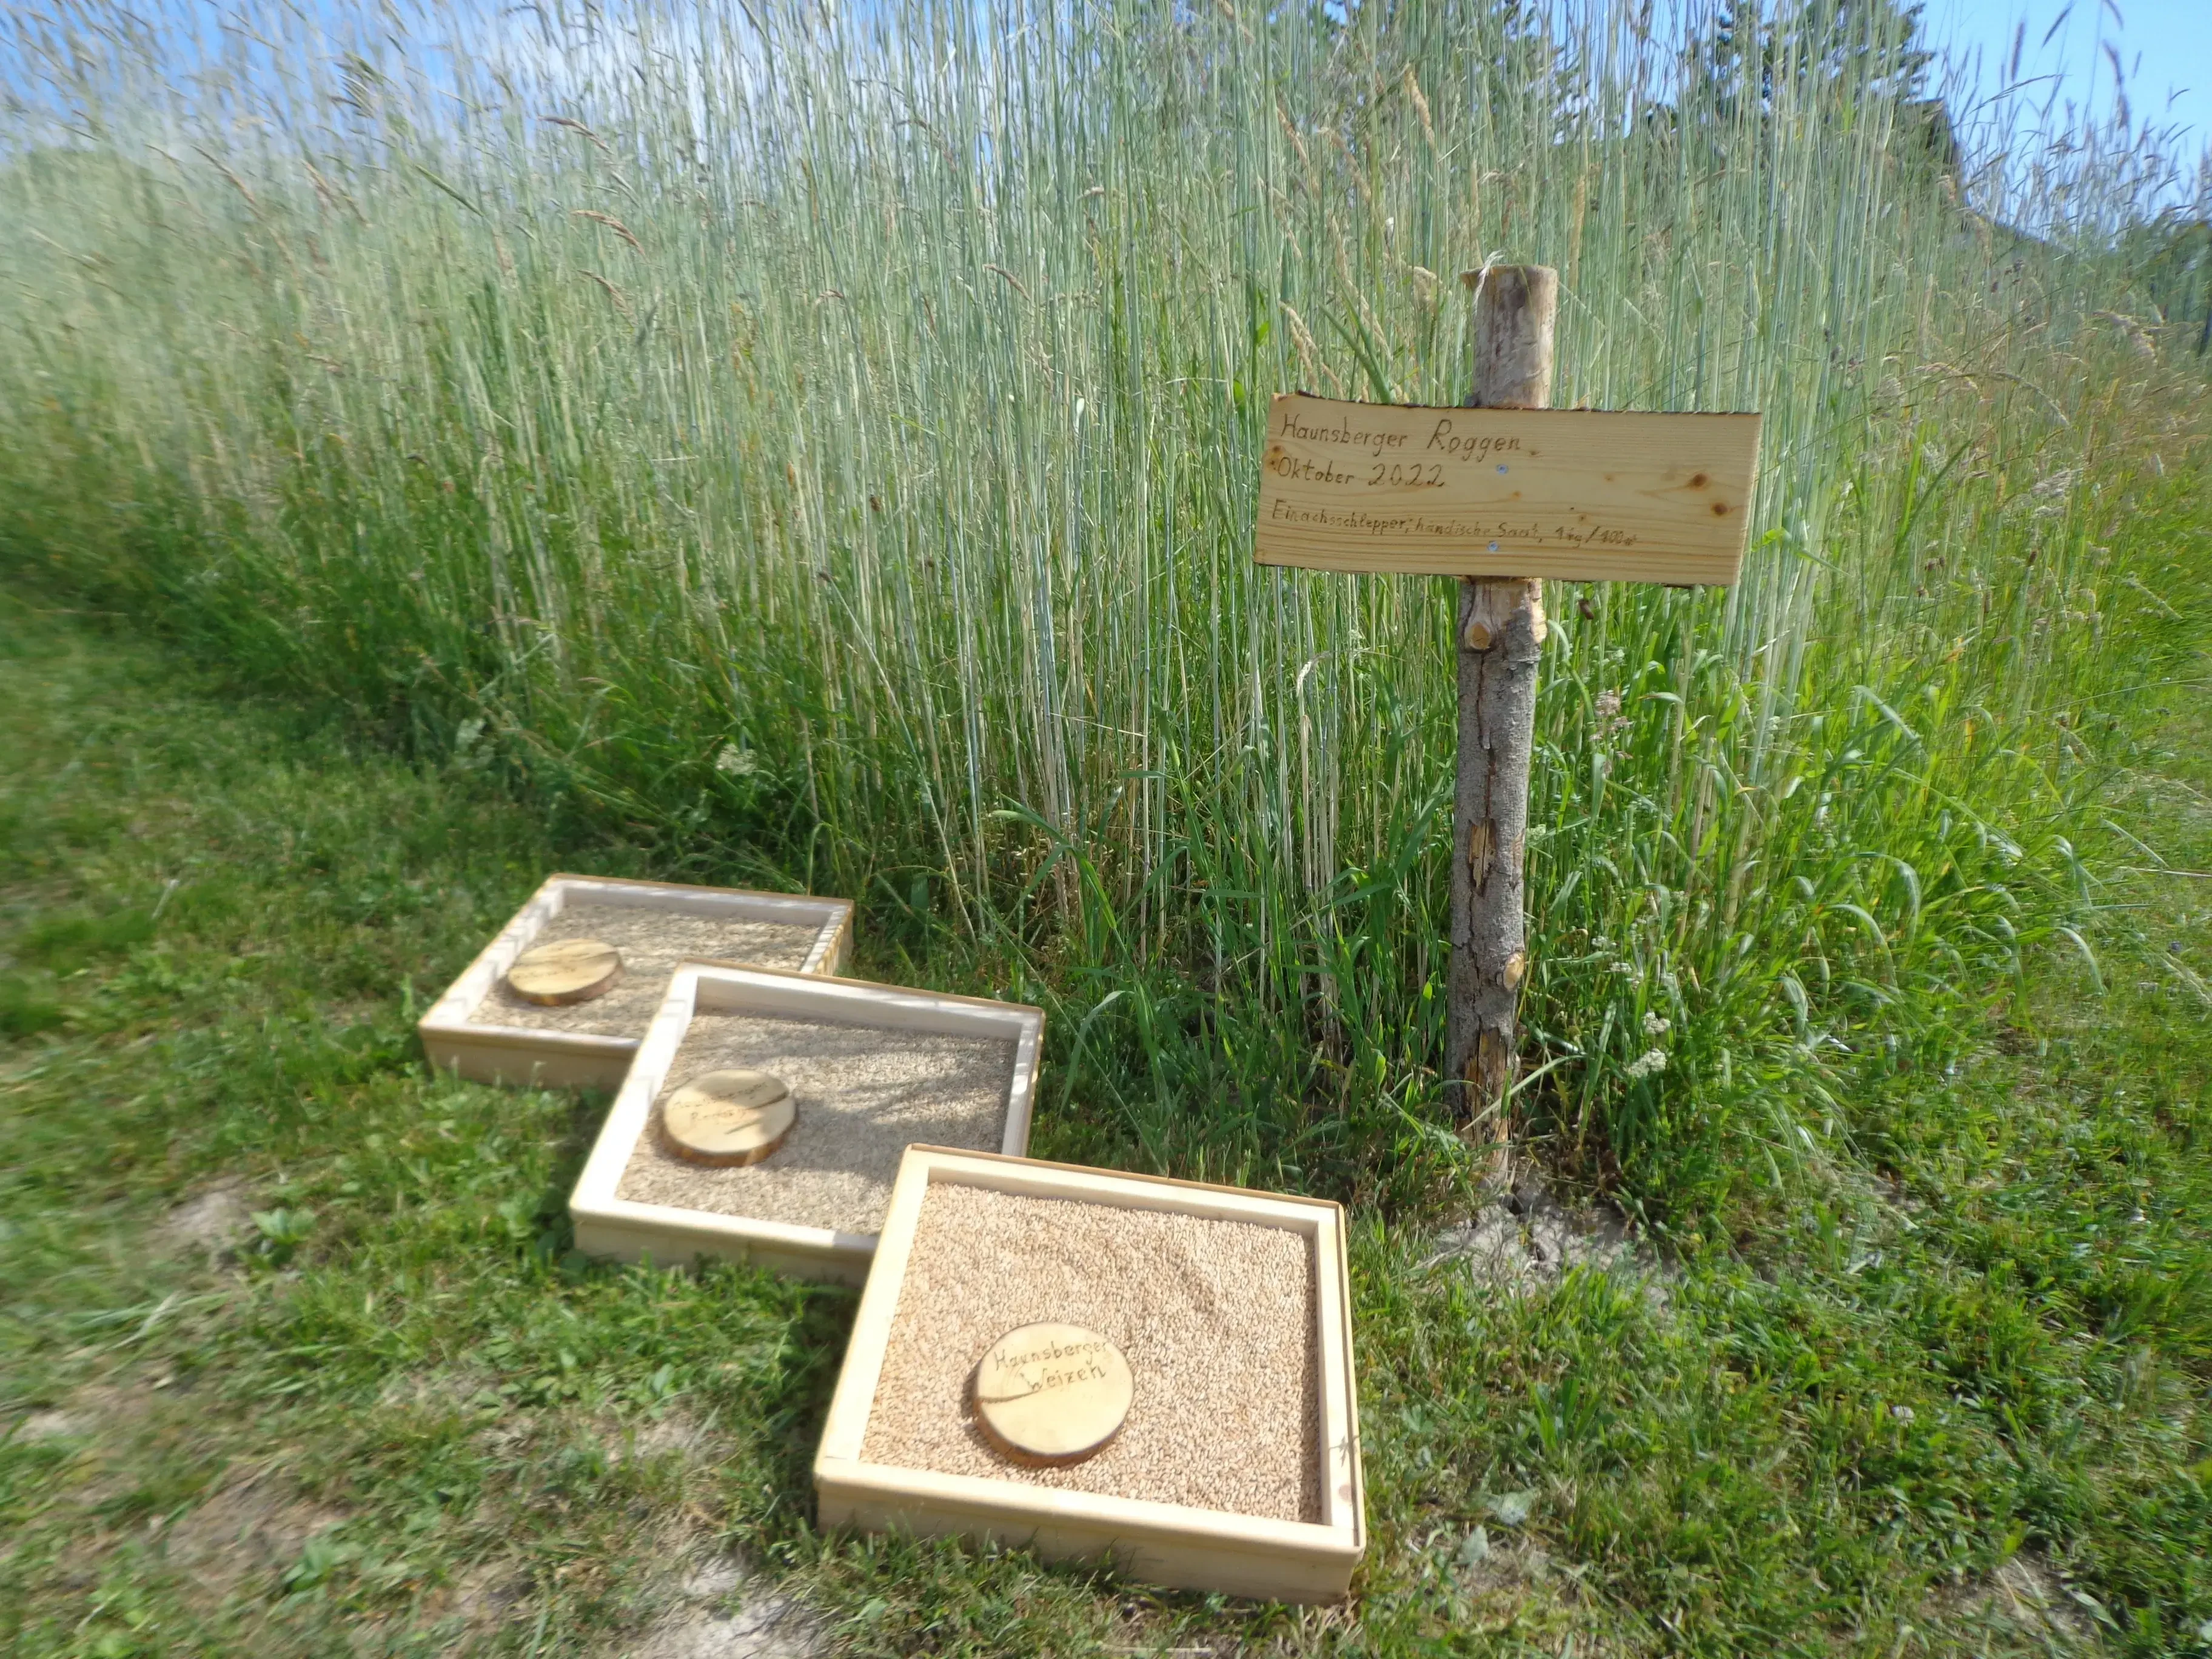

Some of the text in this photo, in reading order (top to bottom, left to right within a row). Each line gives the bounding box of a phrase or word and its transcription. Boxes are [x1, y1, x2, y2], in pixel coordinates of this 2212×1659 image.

[1281, 414, 1520, 462] Haunsberger Roggen
[1278, 457, 1444, 487] Oktober 2022
[994, 1341, 1108, 1371] Haunsberger
[1020, 1365, 1106, 1393] Weizen
